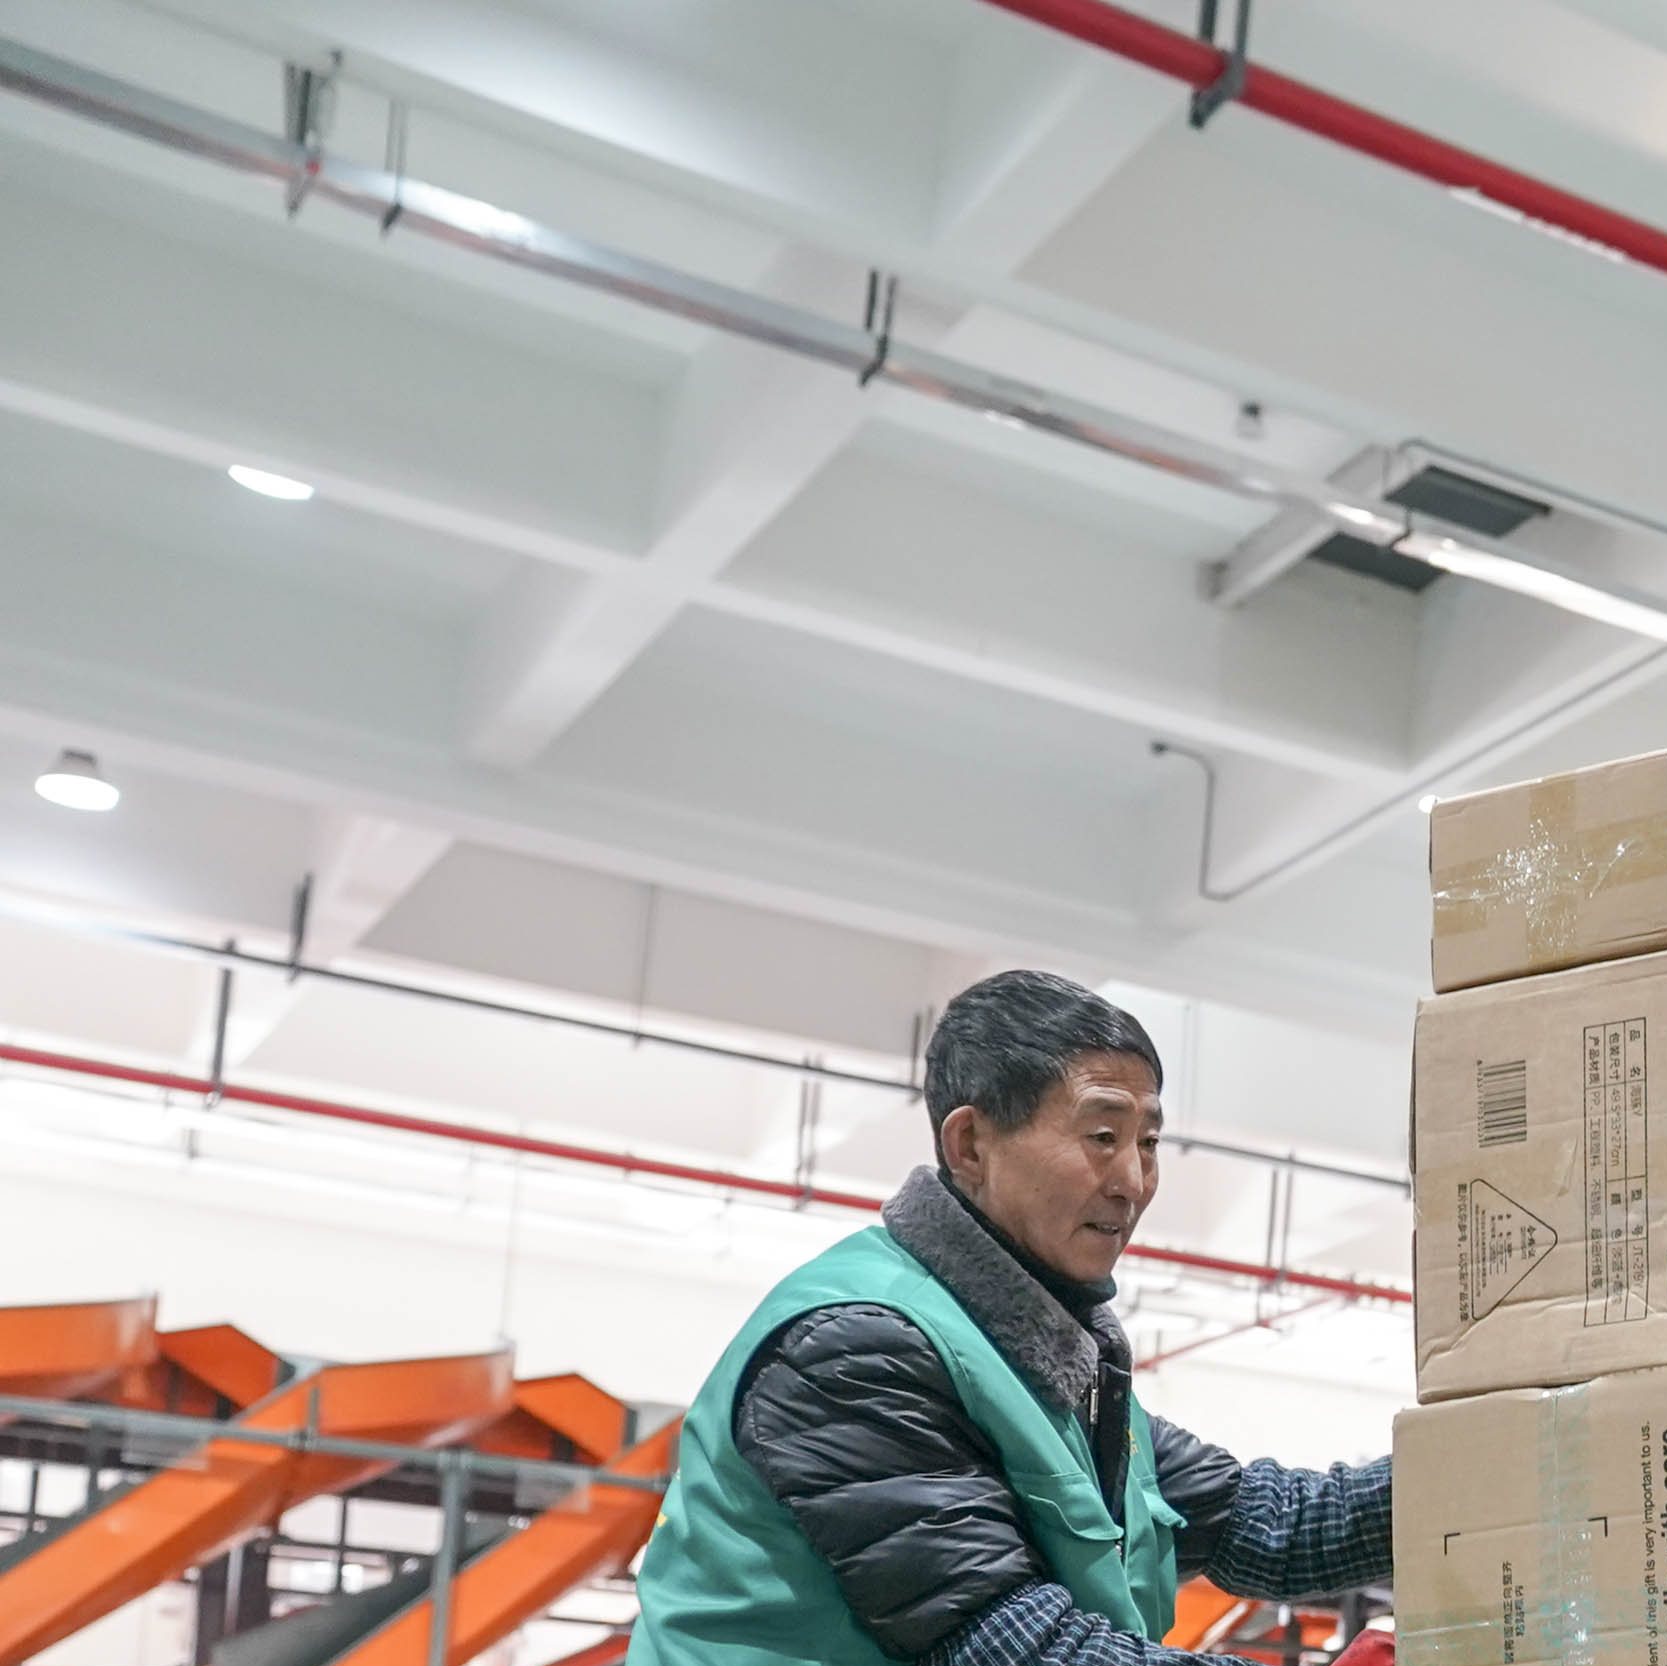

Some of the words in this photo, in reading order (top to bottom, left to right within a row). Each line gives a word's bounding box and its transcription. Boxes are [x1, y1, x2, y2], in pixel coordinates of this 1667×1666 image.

[1589, 1035, 1603, 1085] 产品材质
[1608, 1031, 1622, 1081] 包装尺寸
[1641, 1444, 1652, 1459] to
[1642, 1460, 1657, 1525] important
[1644, 1528, 1657, 1557] very
[1644, 1559, 1656, 1572] is
[1645, 1573, 1658, 1596] gift
[1646, 1625, 1658, 1639] of
